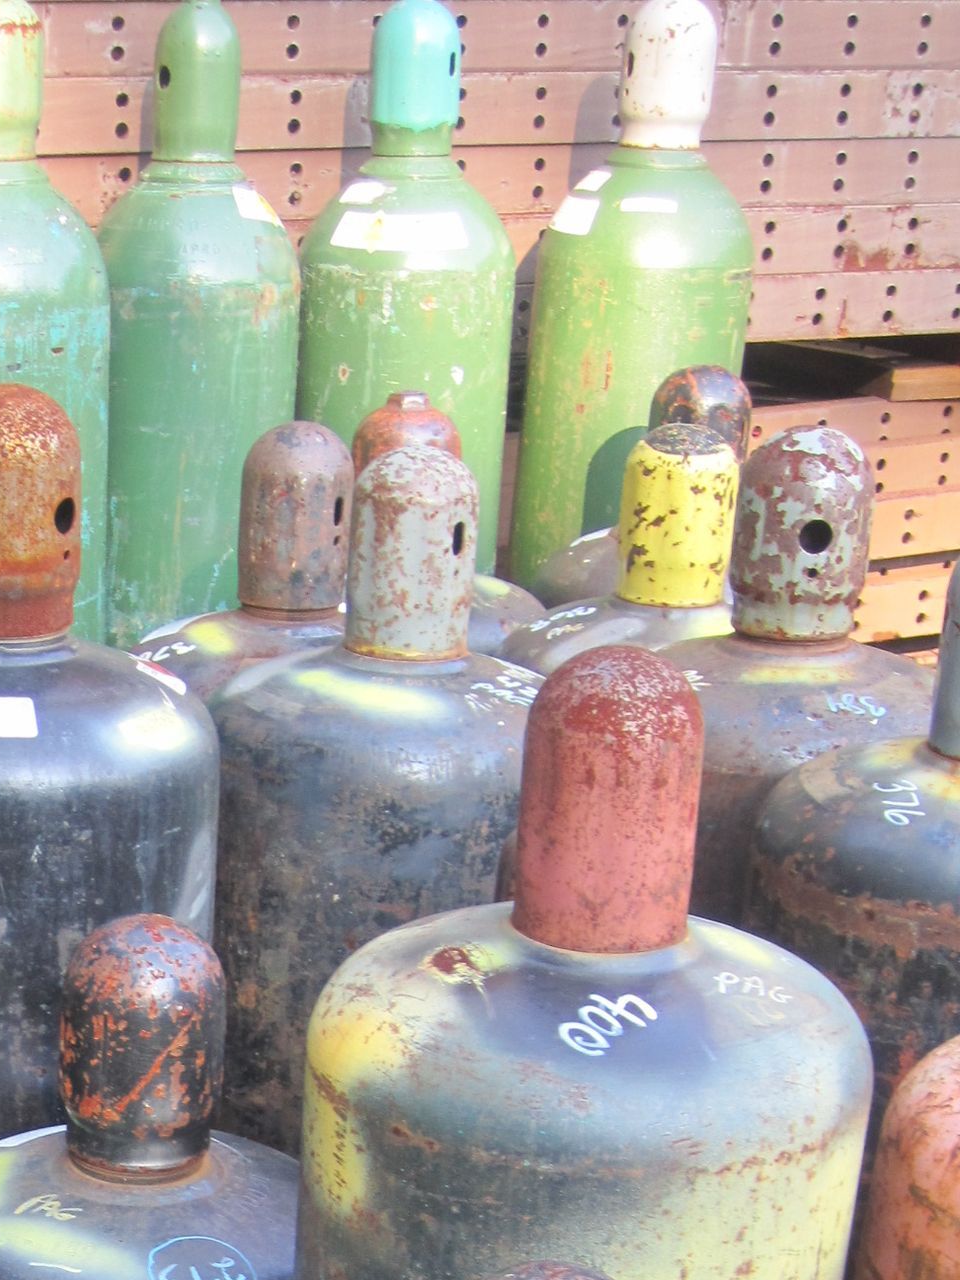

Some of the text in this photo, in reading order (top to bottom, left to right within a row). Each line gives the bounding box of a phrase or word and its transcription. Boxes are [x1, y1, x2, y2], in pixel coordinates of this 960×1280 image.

[872, 779, 926, 826] 376
[713, 971, 793, 1003] PAG
[558, 993, 658, 1057] 400
